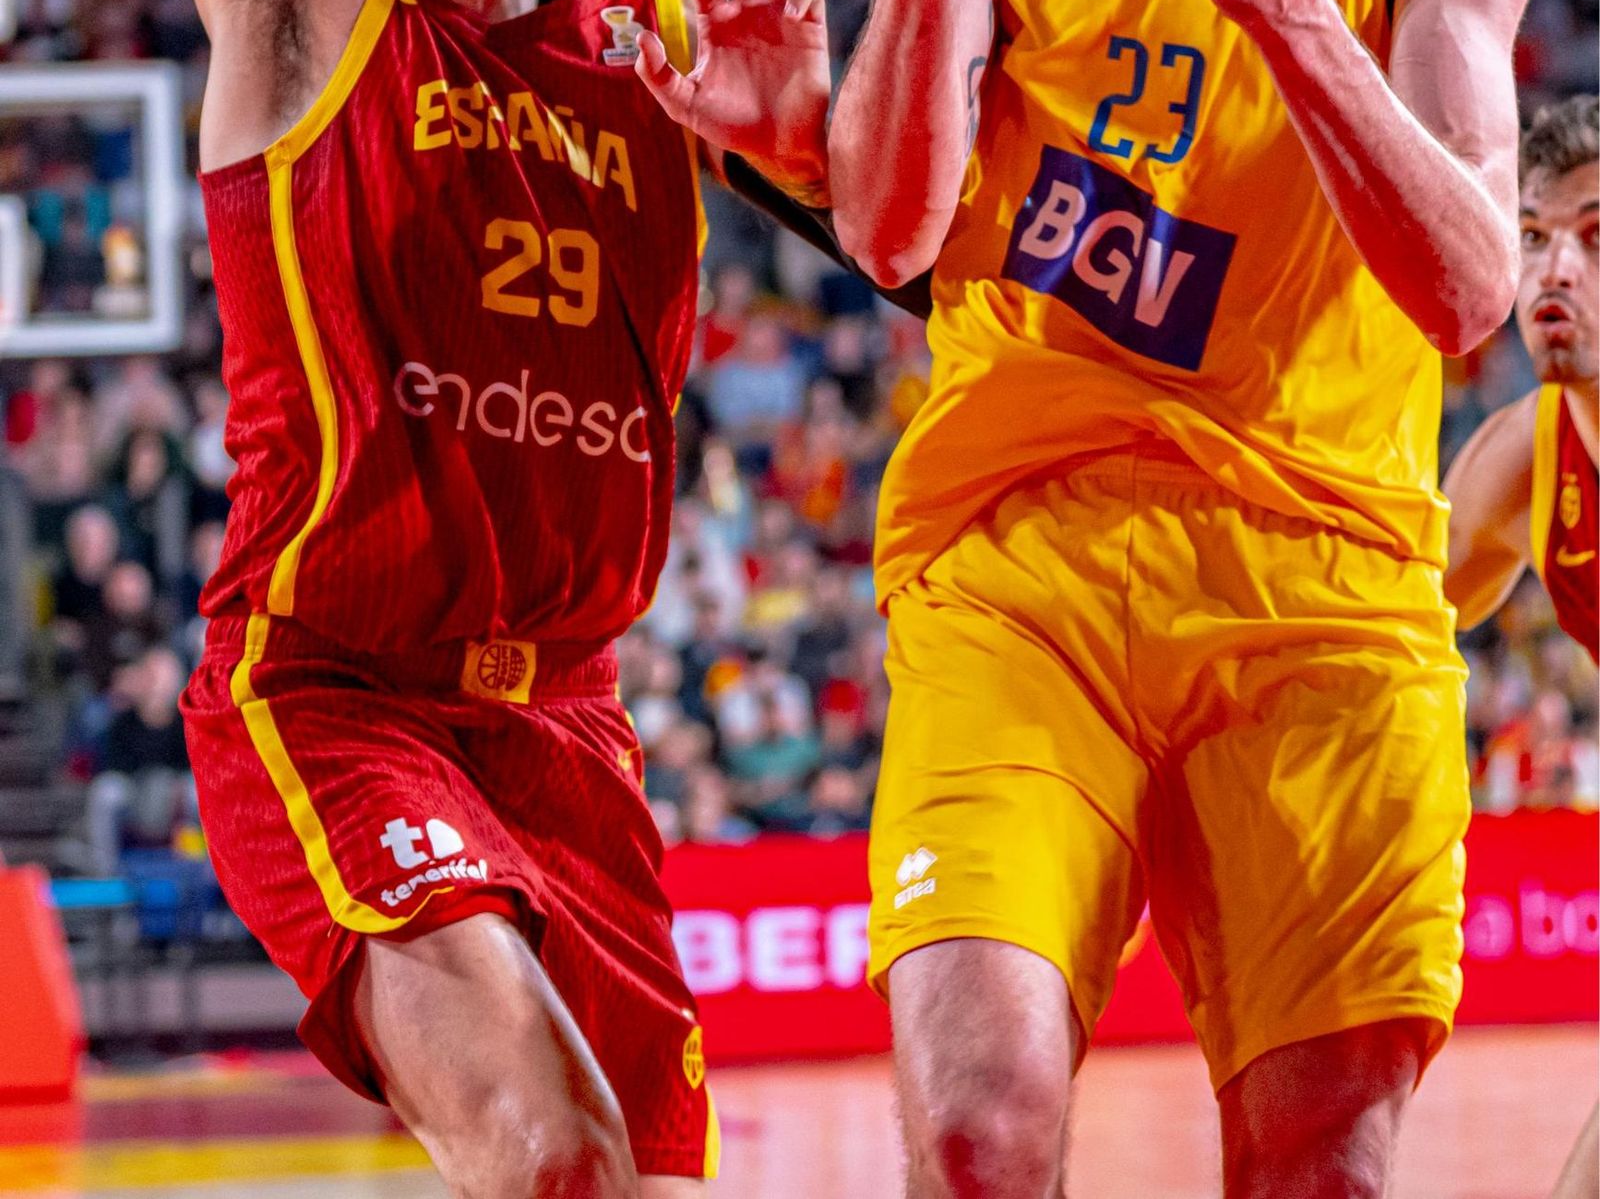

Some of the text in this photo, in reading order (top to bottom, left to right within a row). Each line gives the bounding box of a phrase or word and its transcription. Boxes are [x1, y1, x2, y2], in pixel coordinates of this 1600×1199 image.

[1087, 35, 1207, 163] 23
[481, 218, 600, 328] 29
[1018, 179, 1195, 329] BGV
